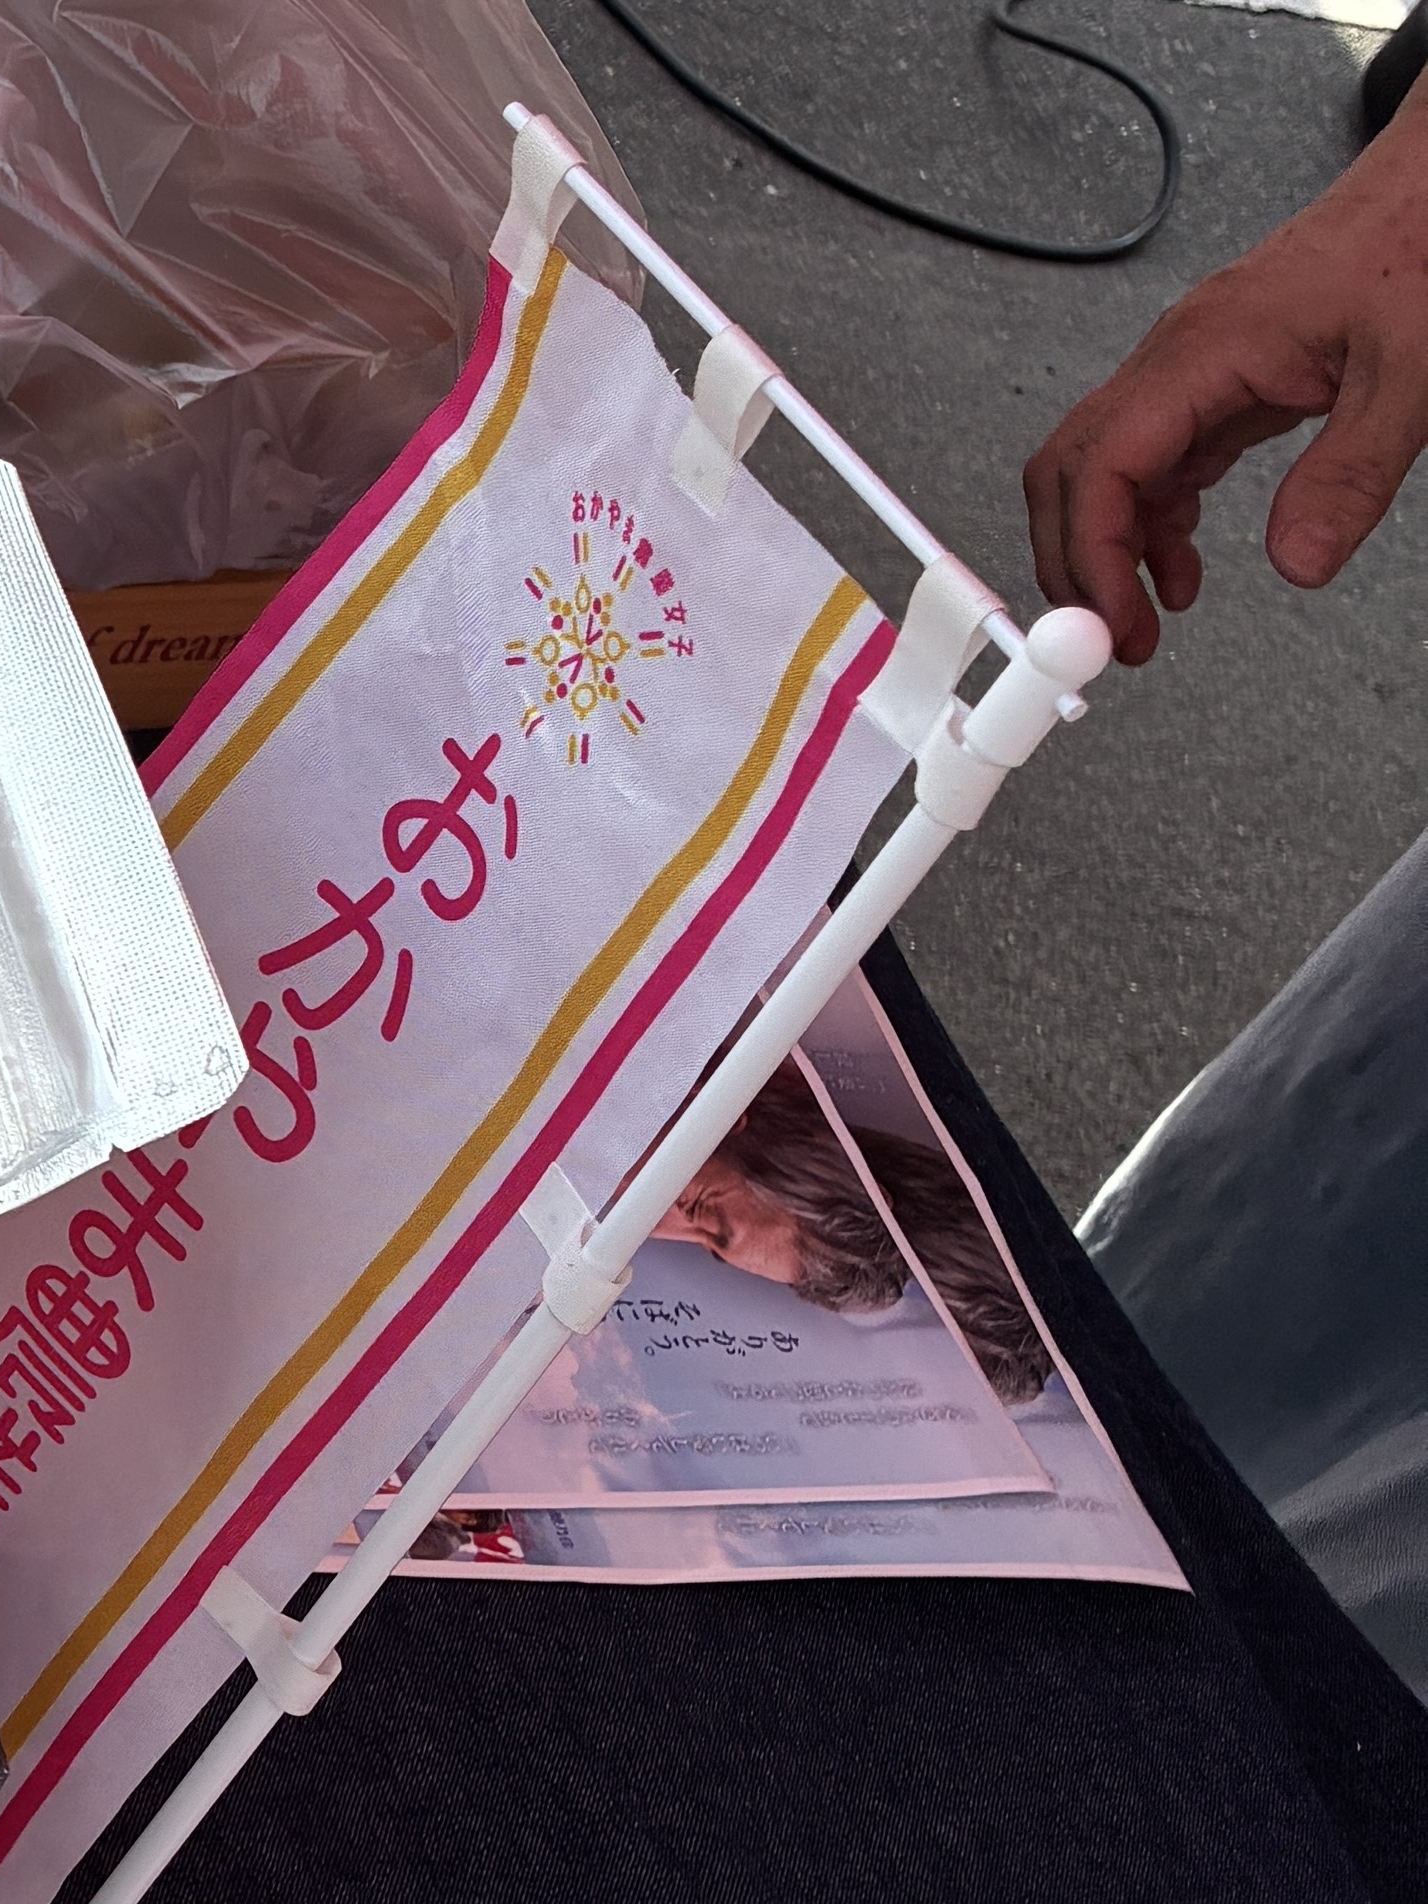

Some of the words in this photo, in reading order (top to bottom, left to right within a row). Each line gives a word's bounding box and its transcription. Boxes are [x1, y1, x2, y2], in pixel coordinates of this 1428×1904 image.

[644, 1328, 799, 1357] ありがとう。
